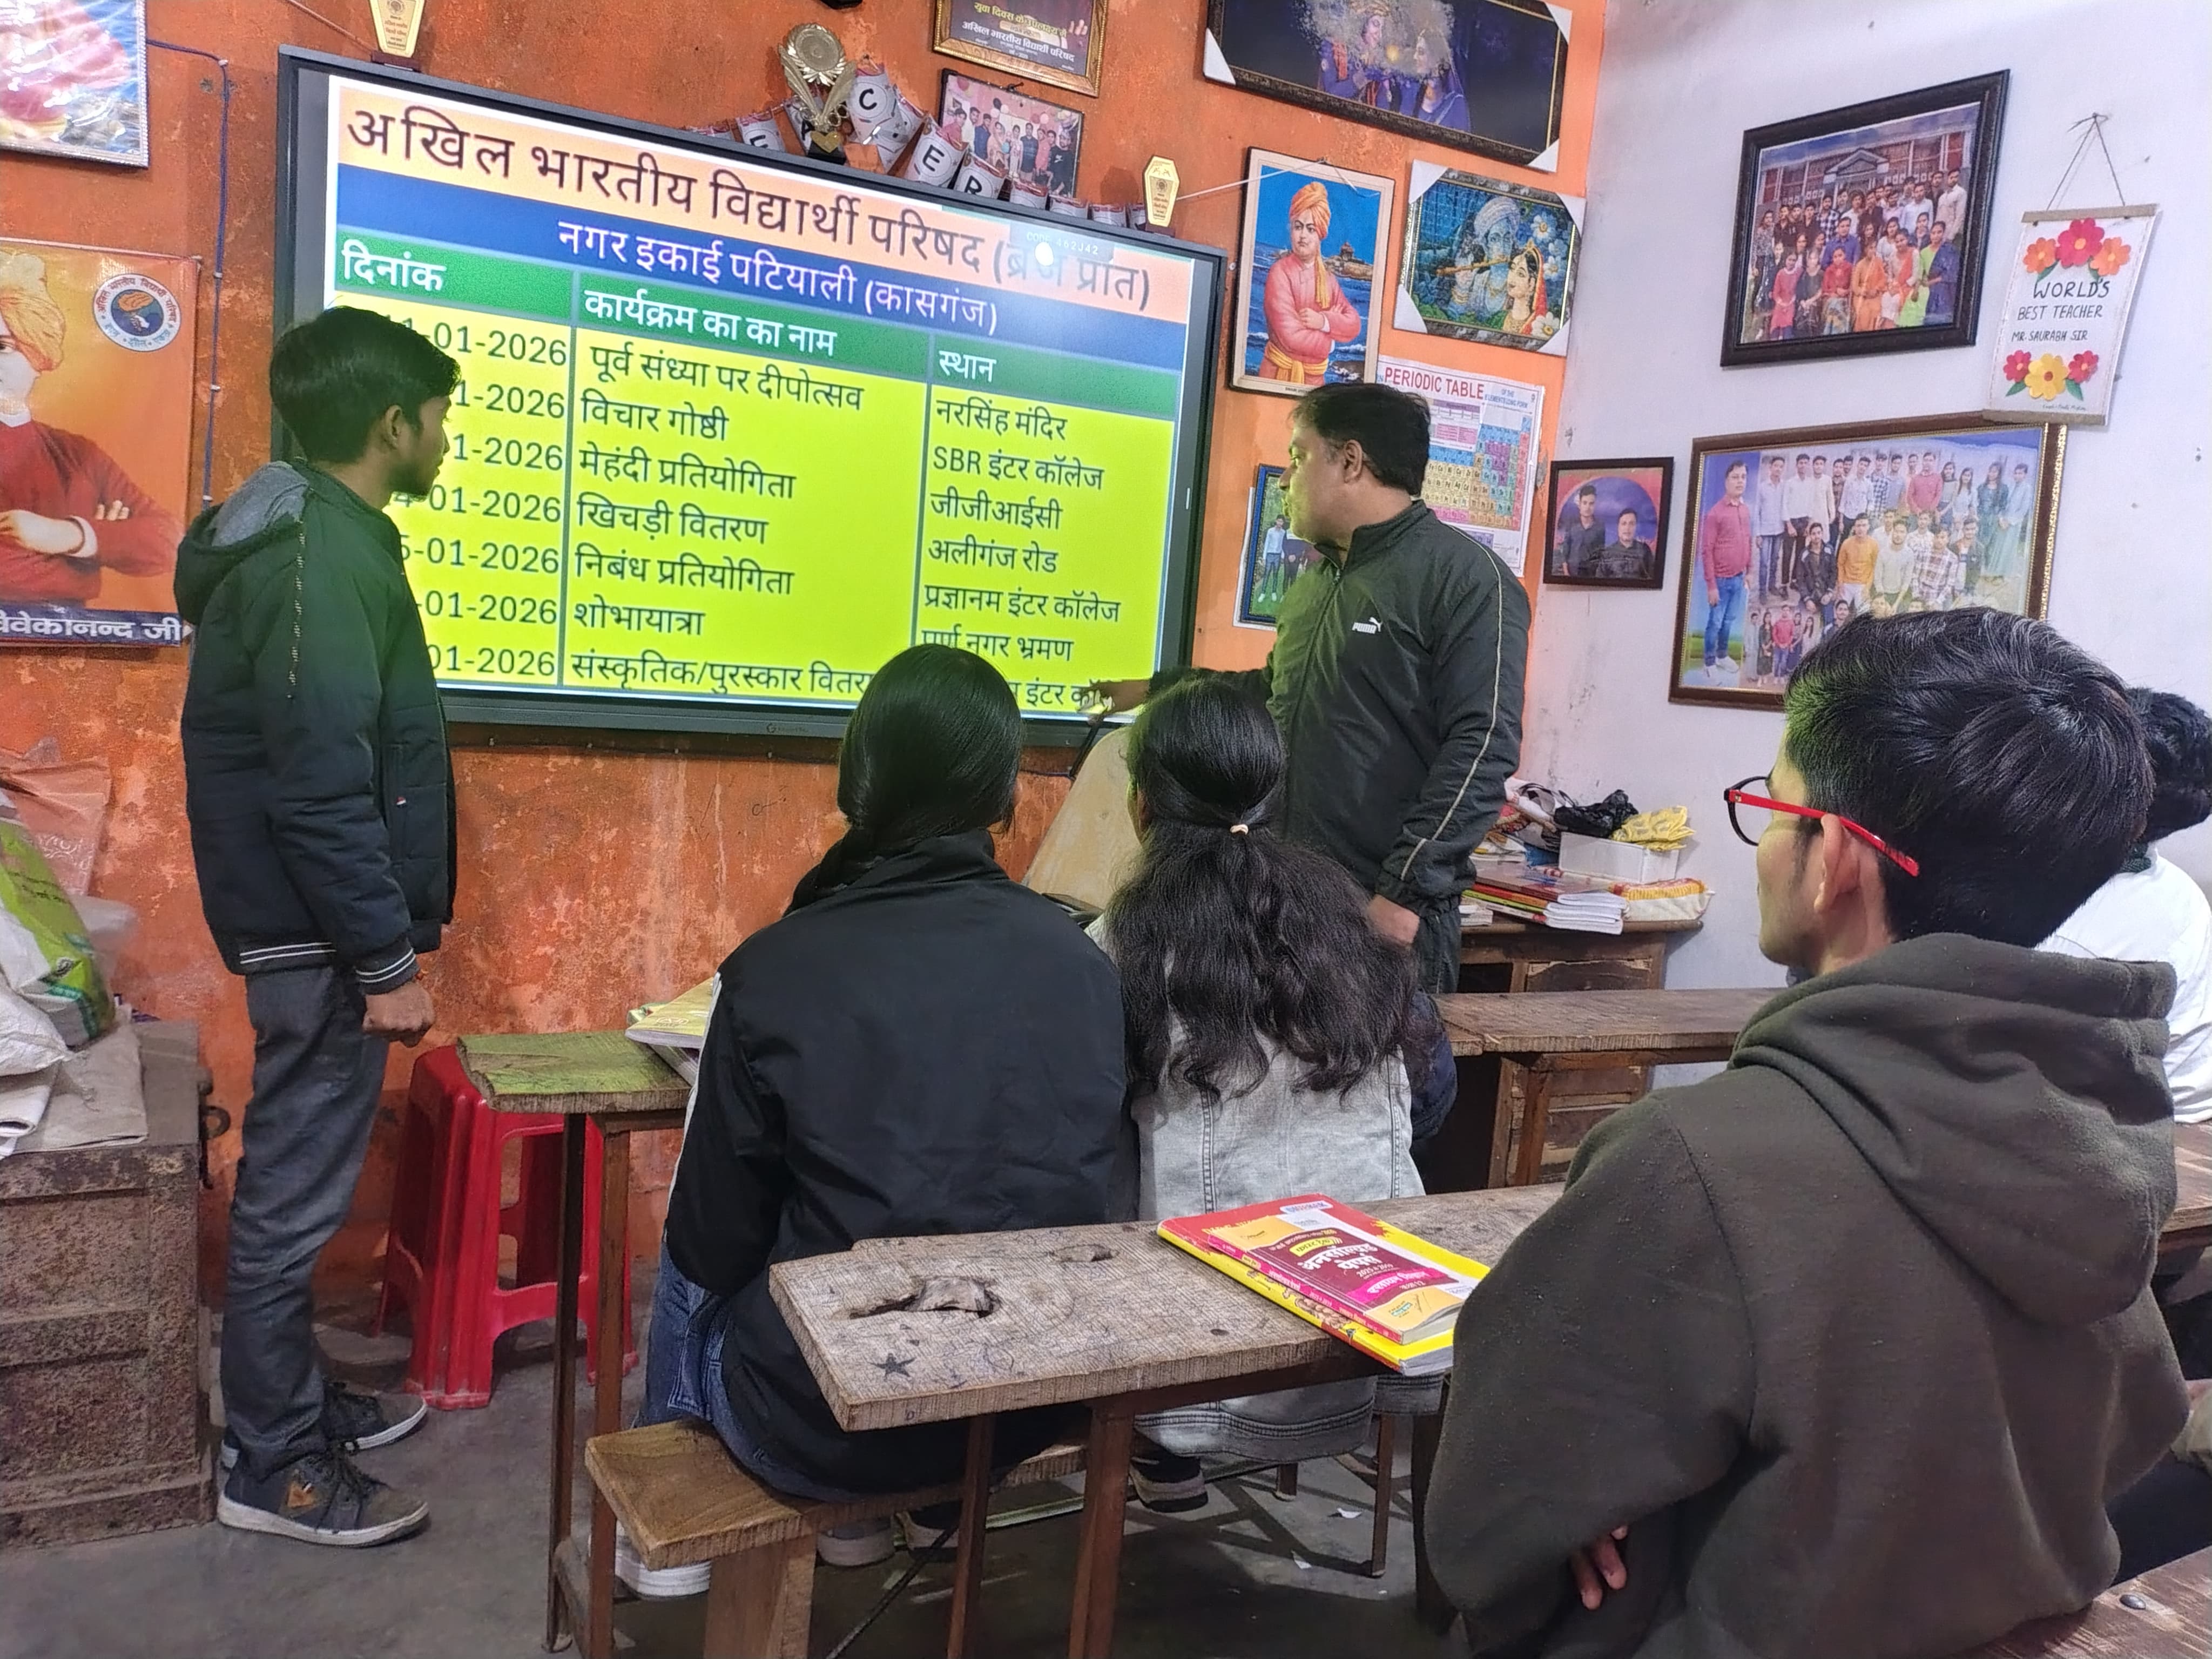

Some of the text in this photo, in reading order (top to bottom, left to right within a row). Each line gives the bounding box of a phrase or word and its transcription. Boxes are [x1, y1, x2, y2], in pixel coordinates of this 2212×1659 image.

[992, 5, 1015, 21] दिवस
[962, 21, 990, 36] अखिल
[990, 30, 1022, 46] भारतीय
[1023, 38, 1049, 54] विद्यार्थी
[1050, 47, 1075, 62] परिषद
[859, 88, 878, 111] C
[922, 145, 945, 172] E
[347, 106, 514, 178] अखिल
[531, 146, 697, 213] भारतीय
[710, 168, 860, 246] विद्यार्थी
[870, 207, 984, 270] परिषद
[558, 221, 998, 335] नगर इकाई पटियाली (कासगंज)
[2033, 278, 2110, 299] WORLD'S
[342, 240, 996, 383] दिनांक कार्यक्रम का का नाम स्थान
[2018, 304, 2104, 320] BEST TEACHER
[402, 318, 567, 366] -01-2026
[2029, 331, 2067, 342] SAURABH
[2071, 330, 2088, 341] SIR
[590, 341, 865, 412] पूर्व संध्या पर दीपोत्सव
[1384, 367, 1485, 400] PERIODIC TABLE
[455, 379, 565, 420] 1-2026
[581, 389, 729, 442] विचार गोष्ठी
[936, 397, 1068, 441] नरसिंह मंदिर
[453, 433, 564, 471] 1-2026
[578, 441, 797, 500] मेहंदी प्रतियोगिता
[933, 447, 1105, 491] SBR इंटर कॉलेज
[577, 493, 769, 545] खिचड़ी वितरण
[930, 486, 1063, 530] जीजीआईसी
[400, 534, 559, 574] 5-01-2026
[575, 543, 795, 596] निबंध प्रतियोगिता
[928, 534, 1058, 574] अलीगंज रोड
[415, 590, 557, 624] -01-2026
[574, 594, 705, 637] शोभायात्रा
[924, 583, 1121, 623] प्रज्ञानम इंटर कॉलेज
[140, 616, 182, 641] जी
[966, 633, 1011, 657] नगर
[1017, 637, 1074, 662] भ्रमण
[427, 644, 555, 677] 01-2026
[571, 648, 875, 695] संस्कृतिक/पुरस्कार वितर
[1026, 677, 1066, 707] इंटर
